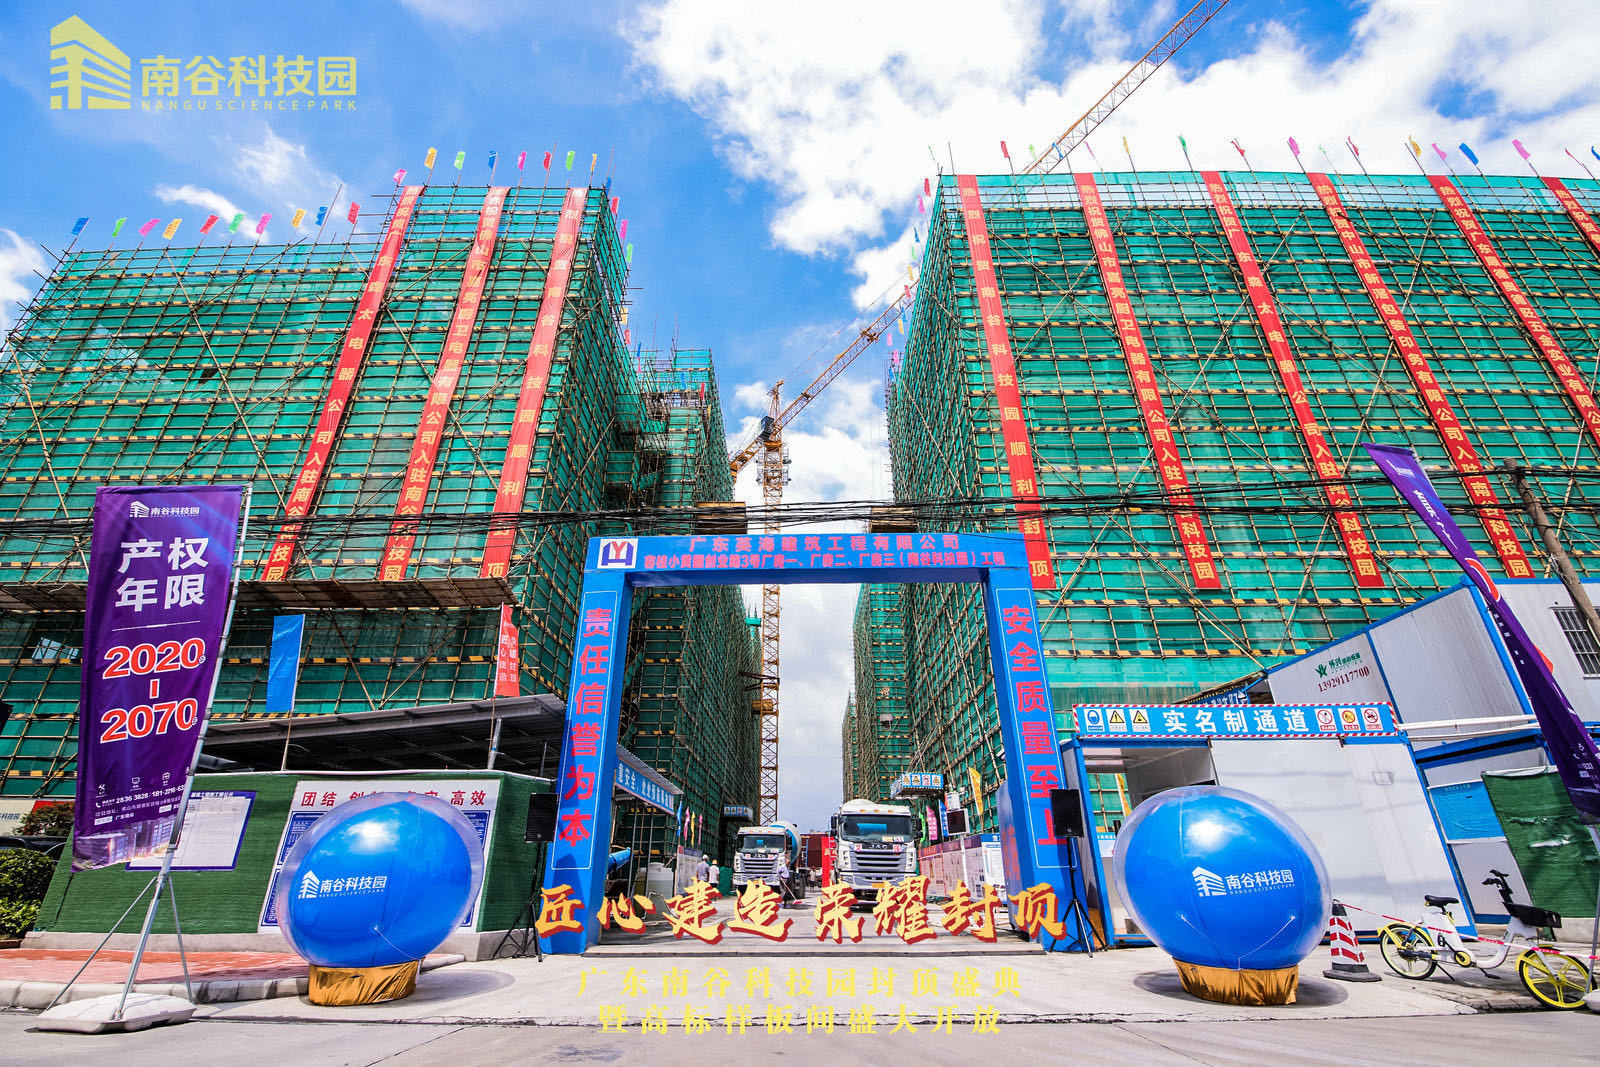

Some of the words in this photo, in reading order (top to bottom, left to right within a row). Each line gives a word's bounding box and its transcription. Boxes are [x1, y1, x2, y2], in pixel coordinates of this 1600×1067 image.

[117, 537, 209, 574] 产权
[115, 573, 206, 612] 年限
[102, 637, 206, 680] 2020
[1318, 666, 1370, 693] 13929117700
[100, 698, 198, 744] 2070
[559, 608, 612, 847] 责任信誉为本
[1163, 709, 1310, 734] 实名制通道
[300, 791, 337, 807] 团结
[450, 790, 487, 806] 高效
[319, 875, 388, 894] 南谷科技园
[1224, 869, 1295, 890] 南谷科技园
